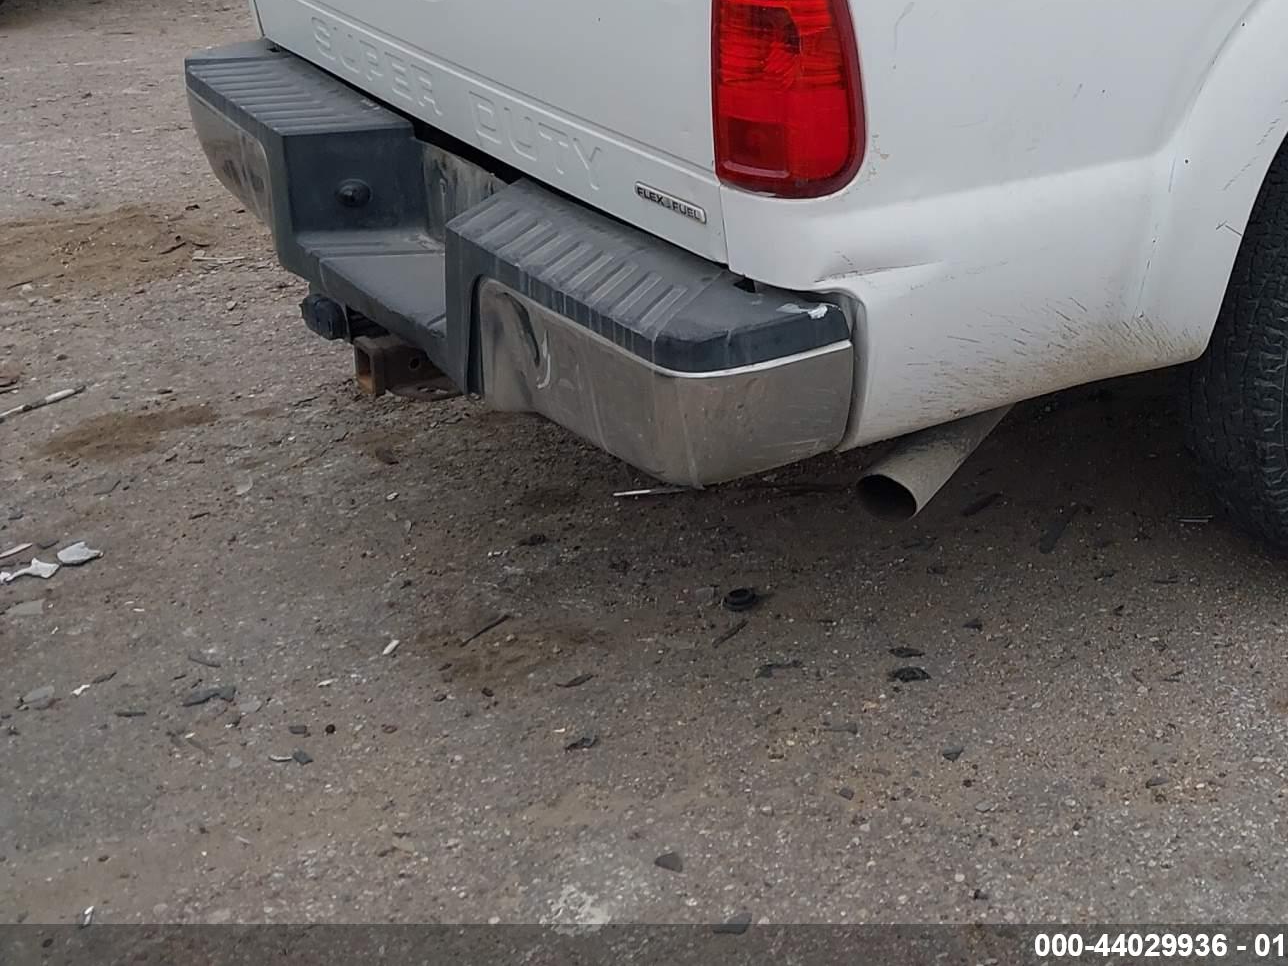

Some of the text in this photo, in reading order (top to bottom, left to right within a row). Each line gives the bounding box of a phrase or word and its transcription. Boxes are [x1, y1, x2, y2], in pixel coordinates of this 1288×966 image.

[311, 16, 602, 191] SUPER DUTY
[636, 187, 701, 220] FLEX FUEL
